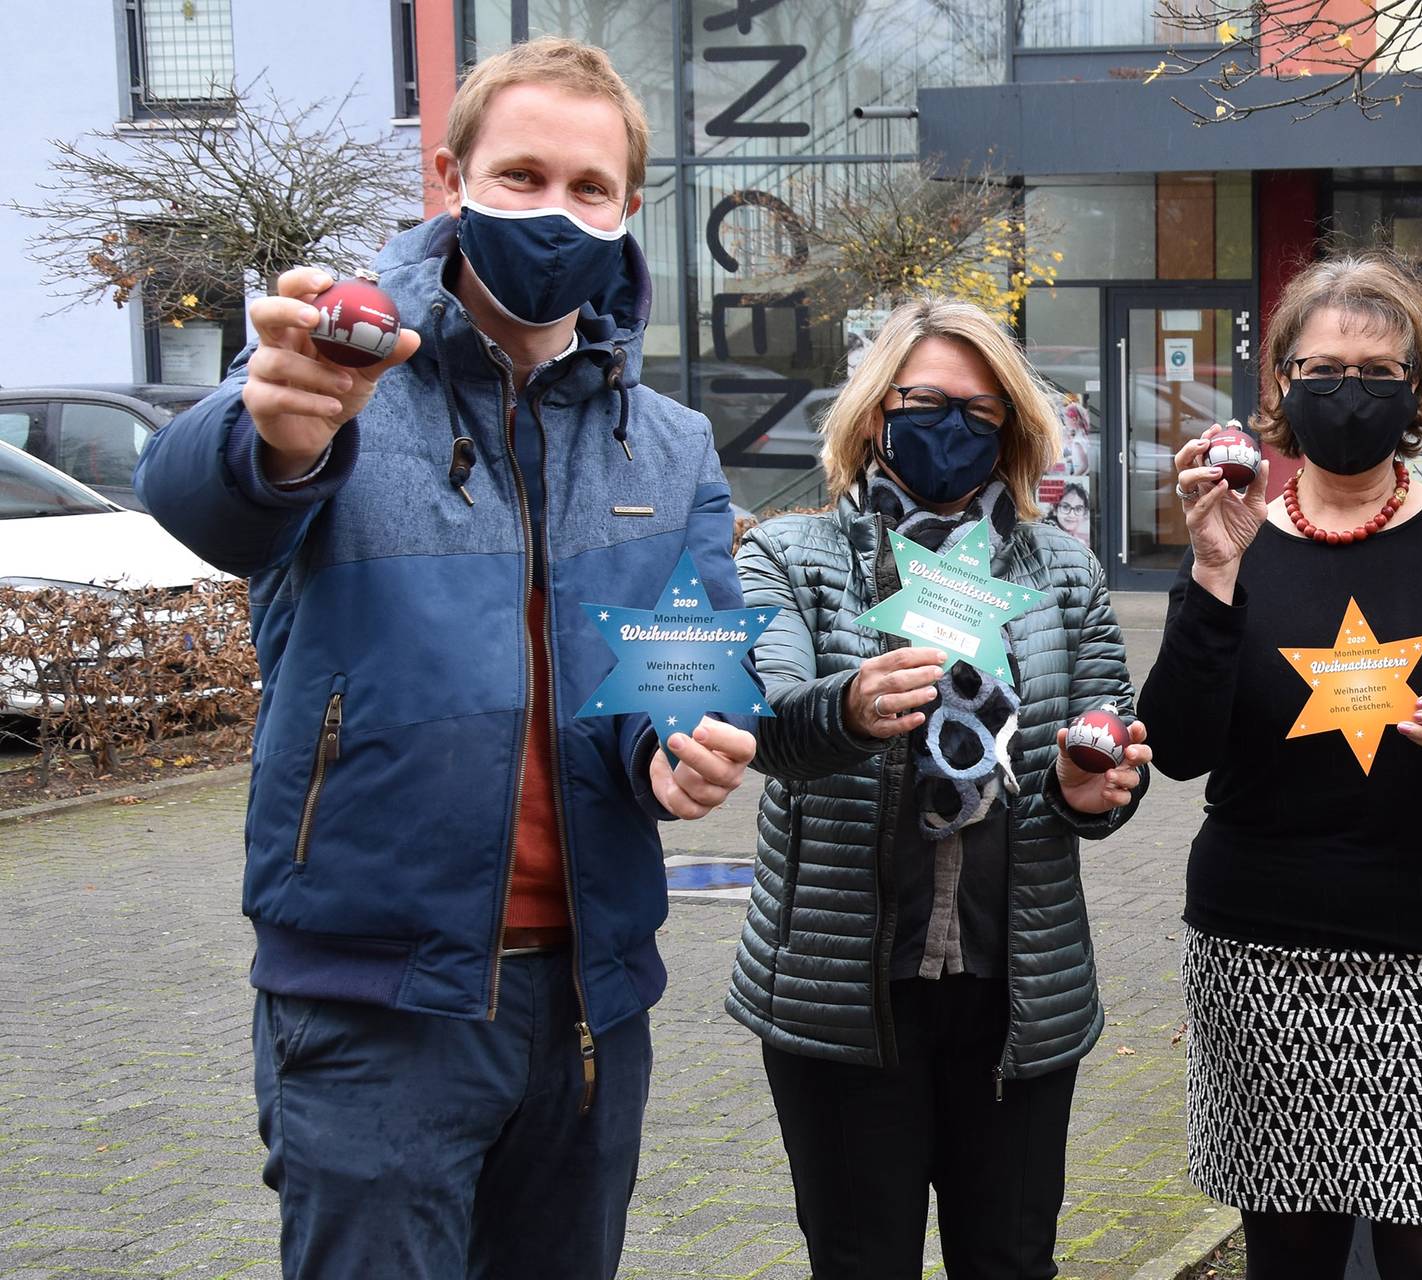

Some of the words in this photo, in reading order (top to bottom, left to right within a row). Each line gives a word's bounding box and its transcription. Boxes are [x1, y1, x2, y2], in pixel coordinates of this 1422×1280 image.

[938, 560, 988, 585] Monheimer
[908, 560, 1011, 611] Weihnachtsstern
[672, 598, 699, 608] 2020
[921, 587, 948, 604] Danke
[950, 598, 963, 609] für
[964, 604, 983, 618] Ihre
[917, 595, 981, 627] Unterstützung!
[653, 614, 715, 624] Monheimer
[620, 624, 748, 642] Weihnachtsstern
[1347, 636, 1366, 644] 2020
[1334, 648, 1381, 658] Monheimer
[646, 661, 715, 671] Weihnachten
[1310, 657, 1409, 675] Weihnachtsstern
[667, 672, 693, 681] nicht
[638, 683, 664, 692] ohne
[667, 683, 720, 692] Geschenk.
[1333, 685, 1387, 696] Weihnachten
[1350, 695, 1372, 703] nicht
[1329, 705, 1350, 714] ohne
[1352, 701, 1394, 712] Geschenk.
